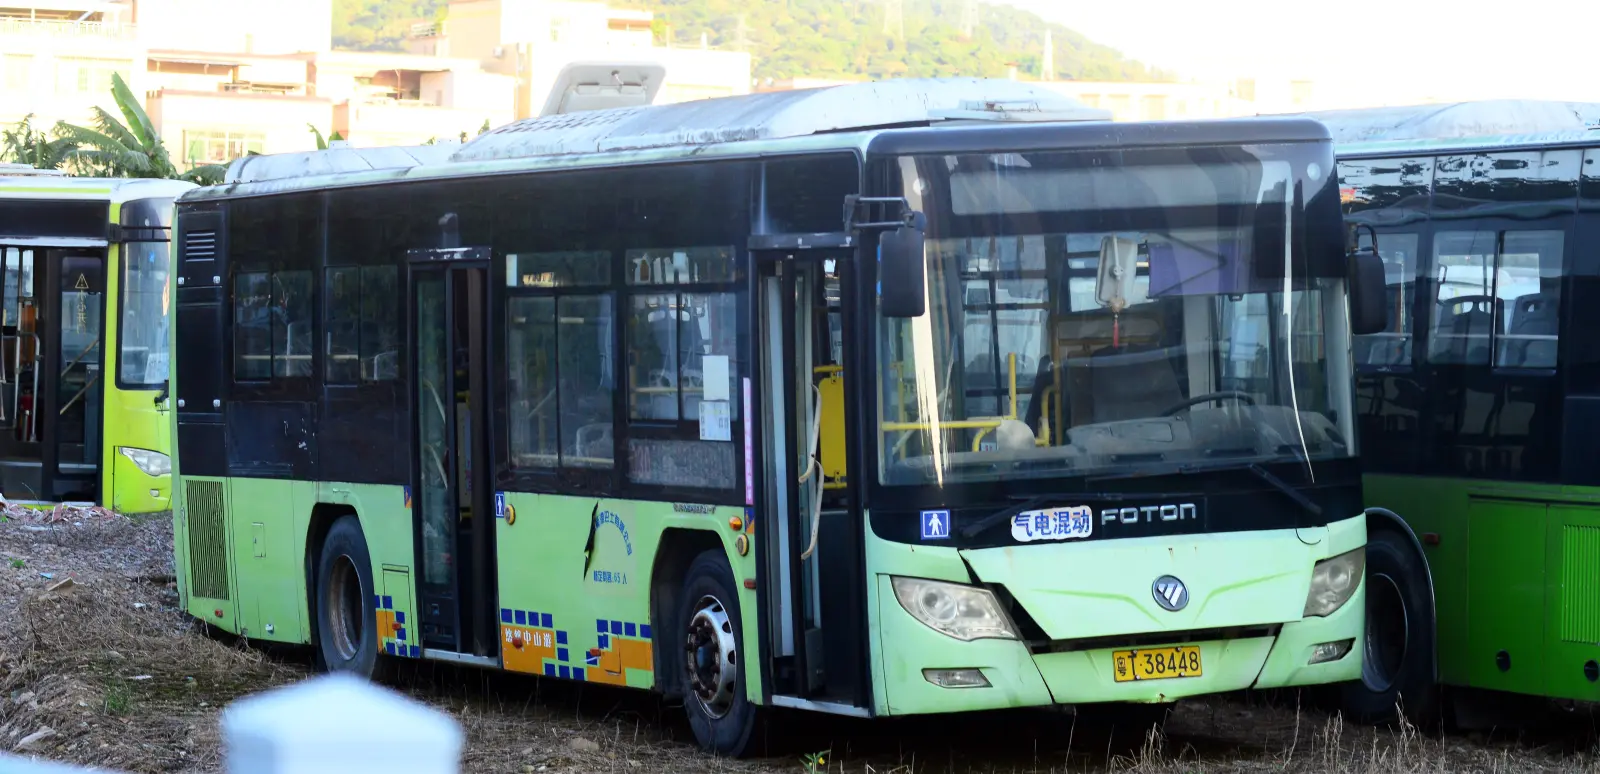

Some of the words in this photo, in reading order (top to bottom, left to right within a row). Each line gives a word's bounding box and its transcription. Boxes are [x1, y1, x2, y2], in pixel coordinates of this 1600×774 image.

[1013, 509, 1090, 537] 气电混动
[1101, 503, 1196, 526] FOTON
